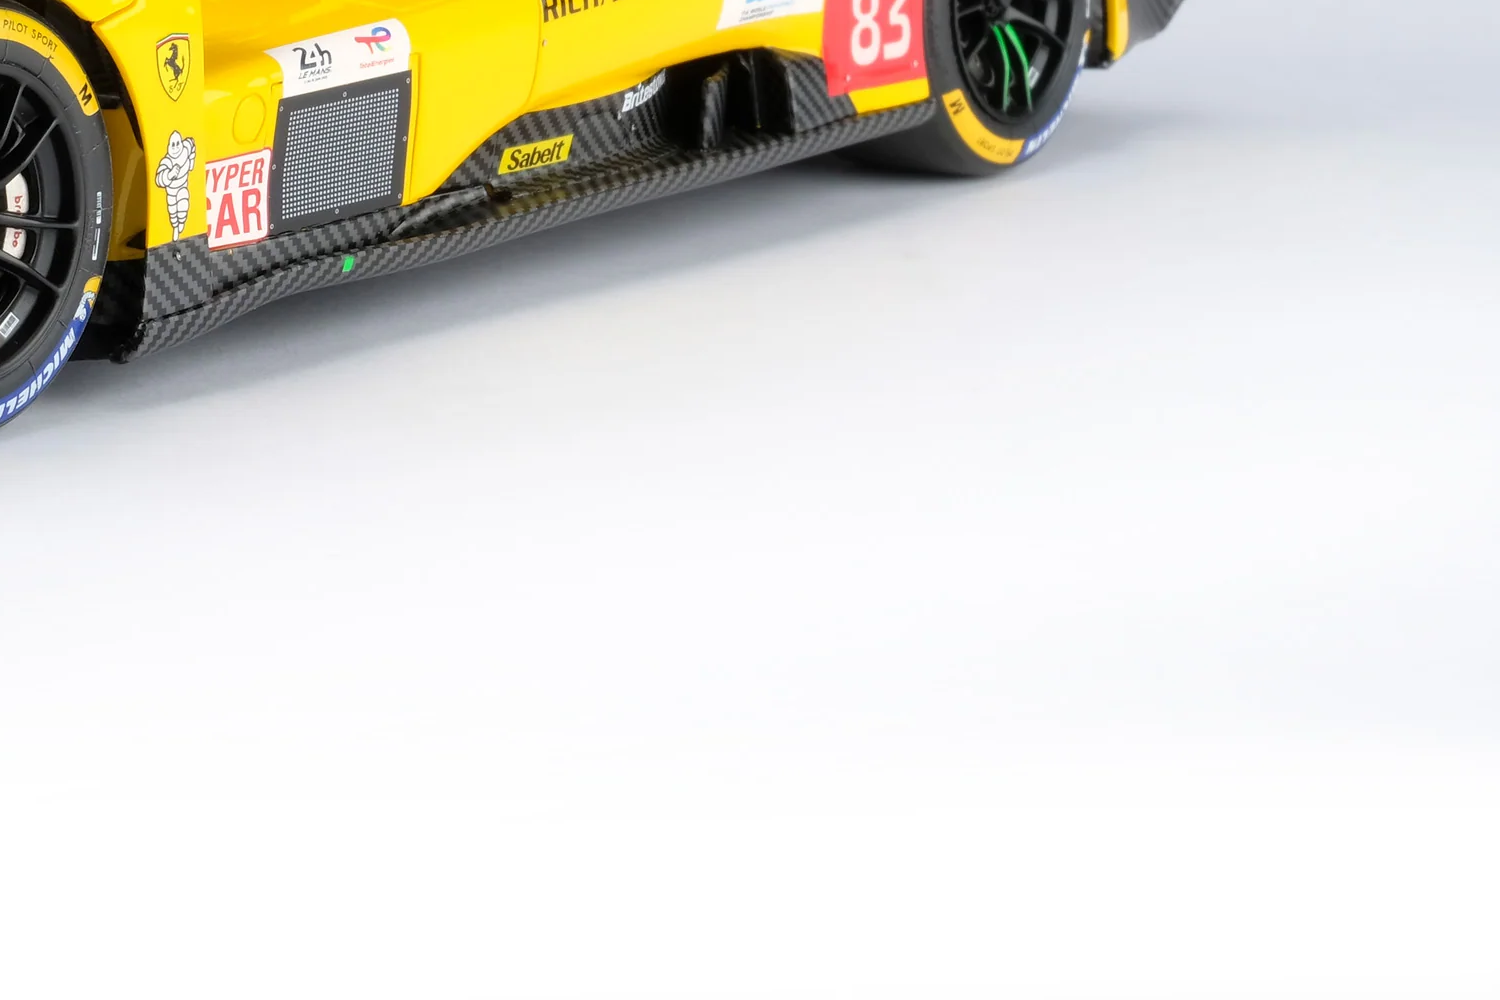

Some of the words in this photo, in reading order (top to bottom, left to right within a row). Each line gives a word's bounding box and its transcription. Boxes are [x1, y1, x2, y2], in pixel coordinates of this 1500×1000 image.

[2, 19, 29, 35] PILOT
[30, 28, 59, 53] SPORT
[292, 42, 333, 71] 24h
[298, 71, 309, 80] LE
[78, 83, 93, 107] M
[507, 139, 565, 171] Sabelt
